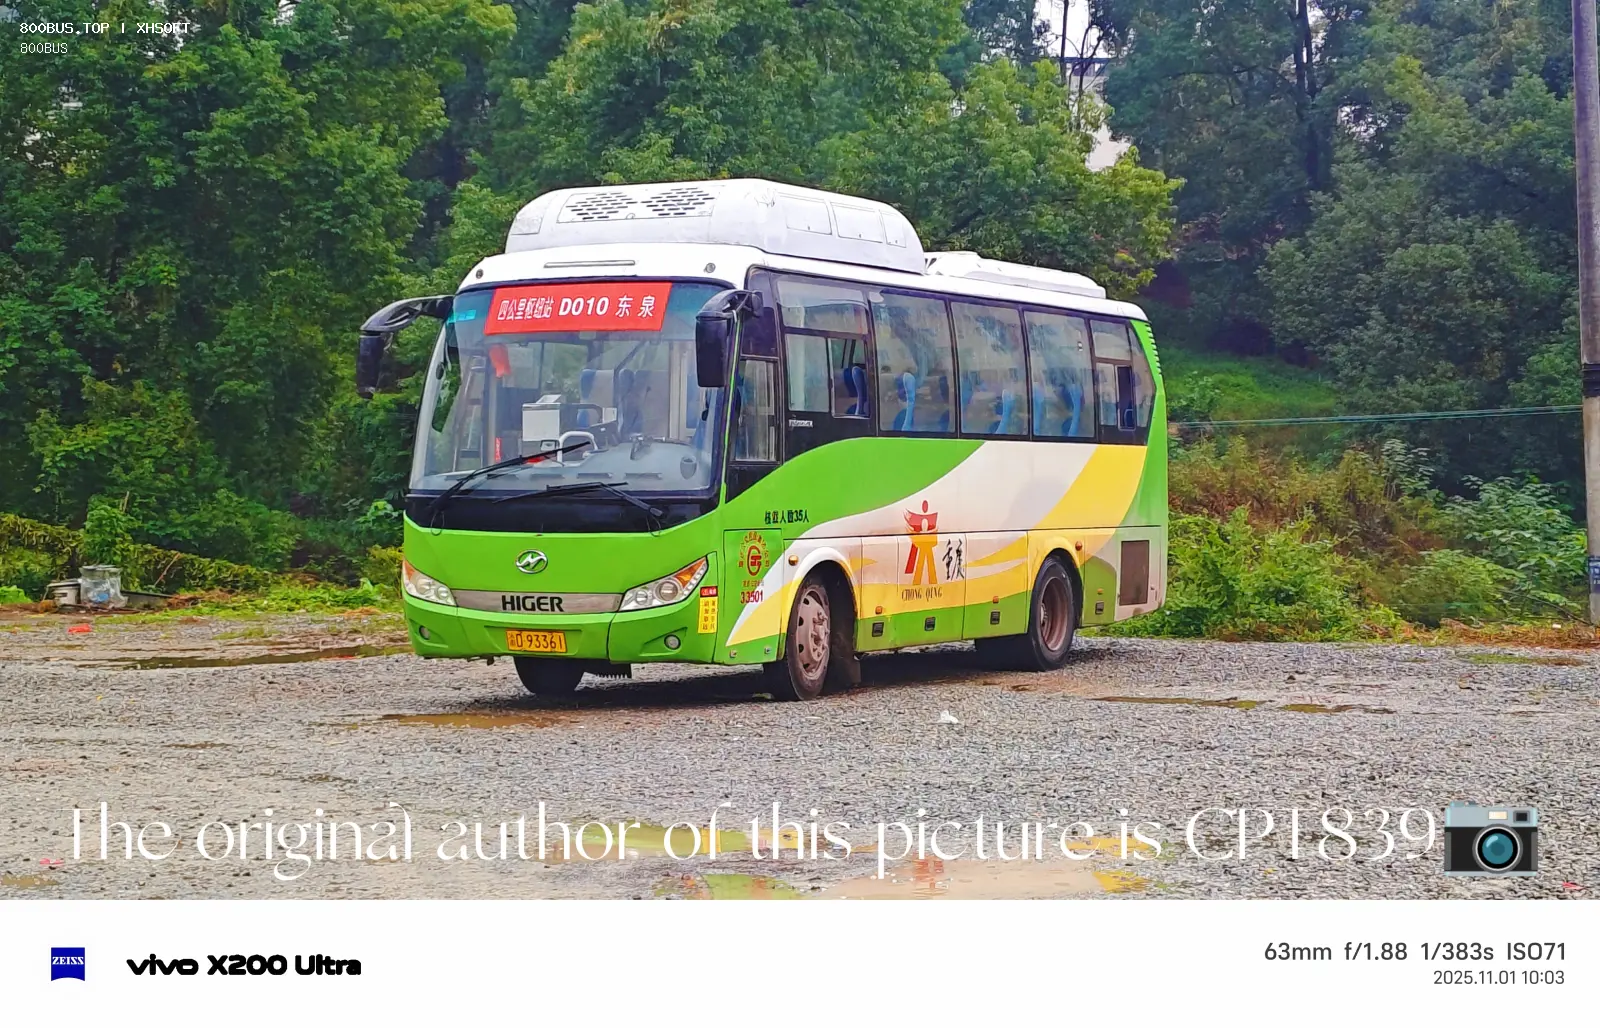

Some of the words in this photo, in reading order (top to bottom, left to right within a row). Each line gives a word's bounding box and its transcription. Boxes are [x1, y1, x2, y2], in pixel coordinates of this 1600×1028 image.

[740, 590, 764, 604] 33501
[901, 587, 922, 601] CHONG
[925, 586, 943, 602] QING
[501, 595, 564, 612] HIGER
